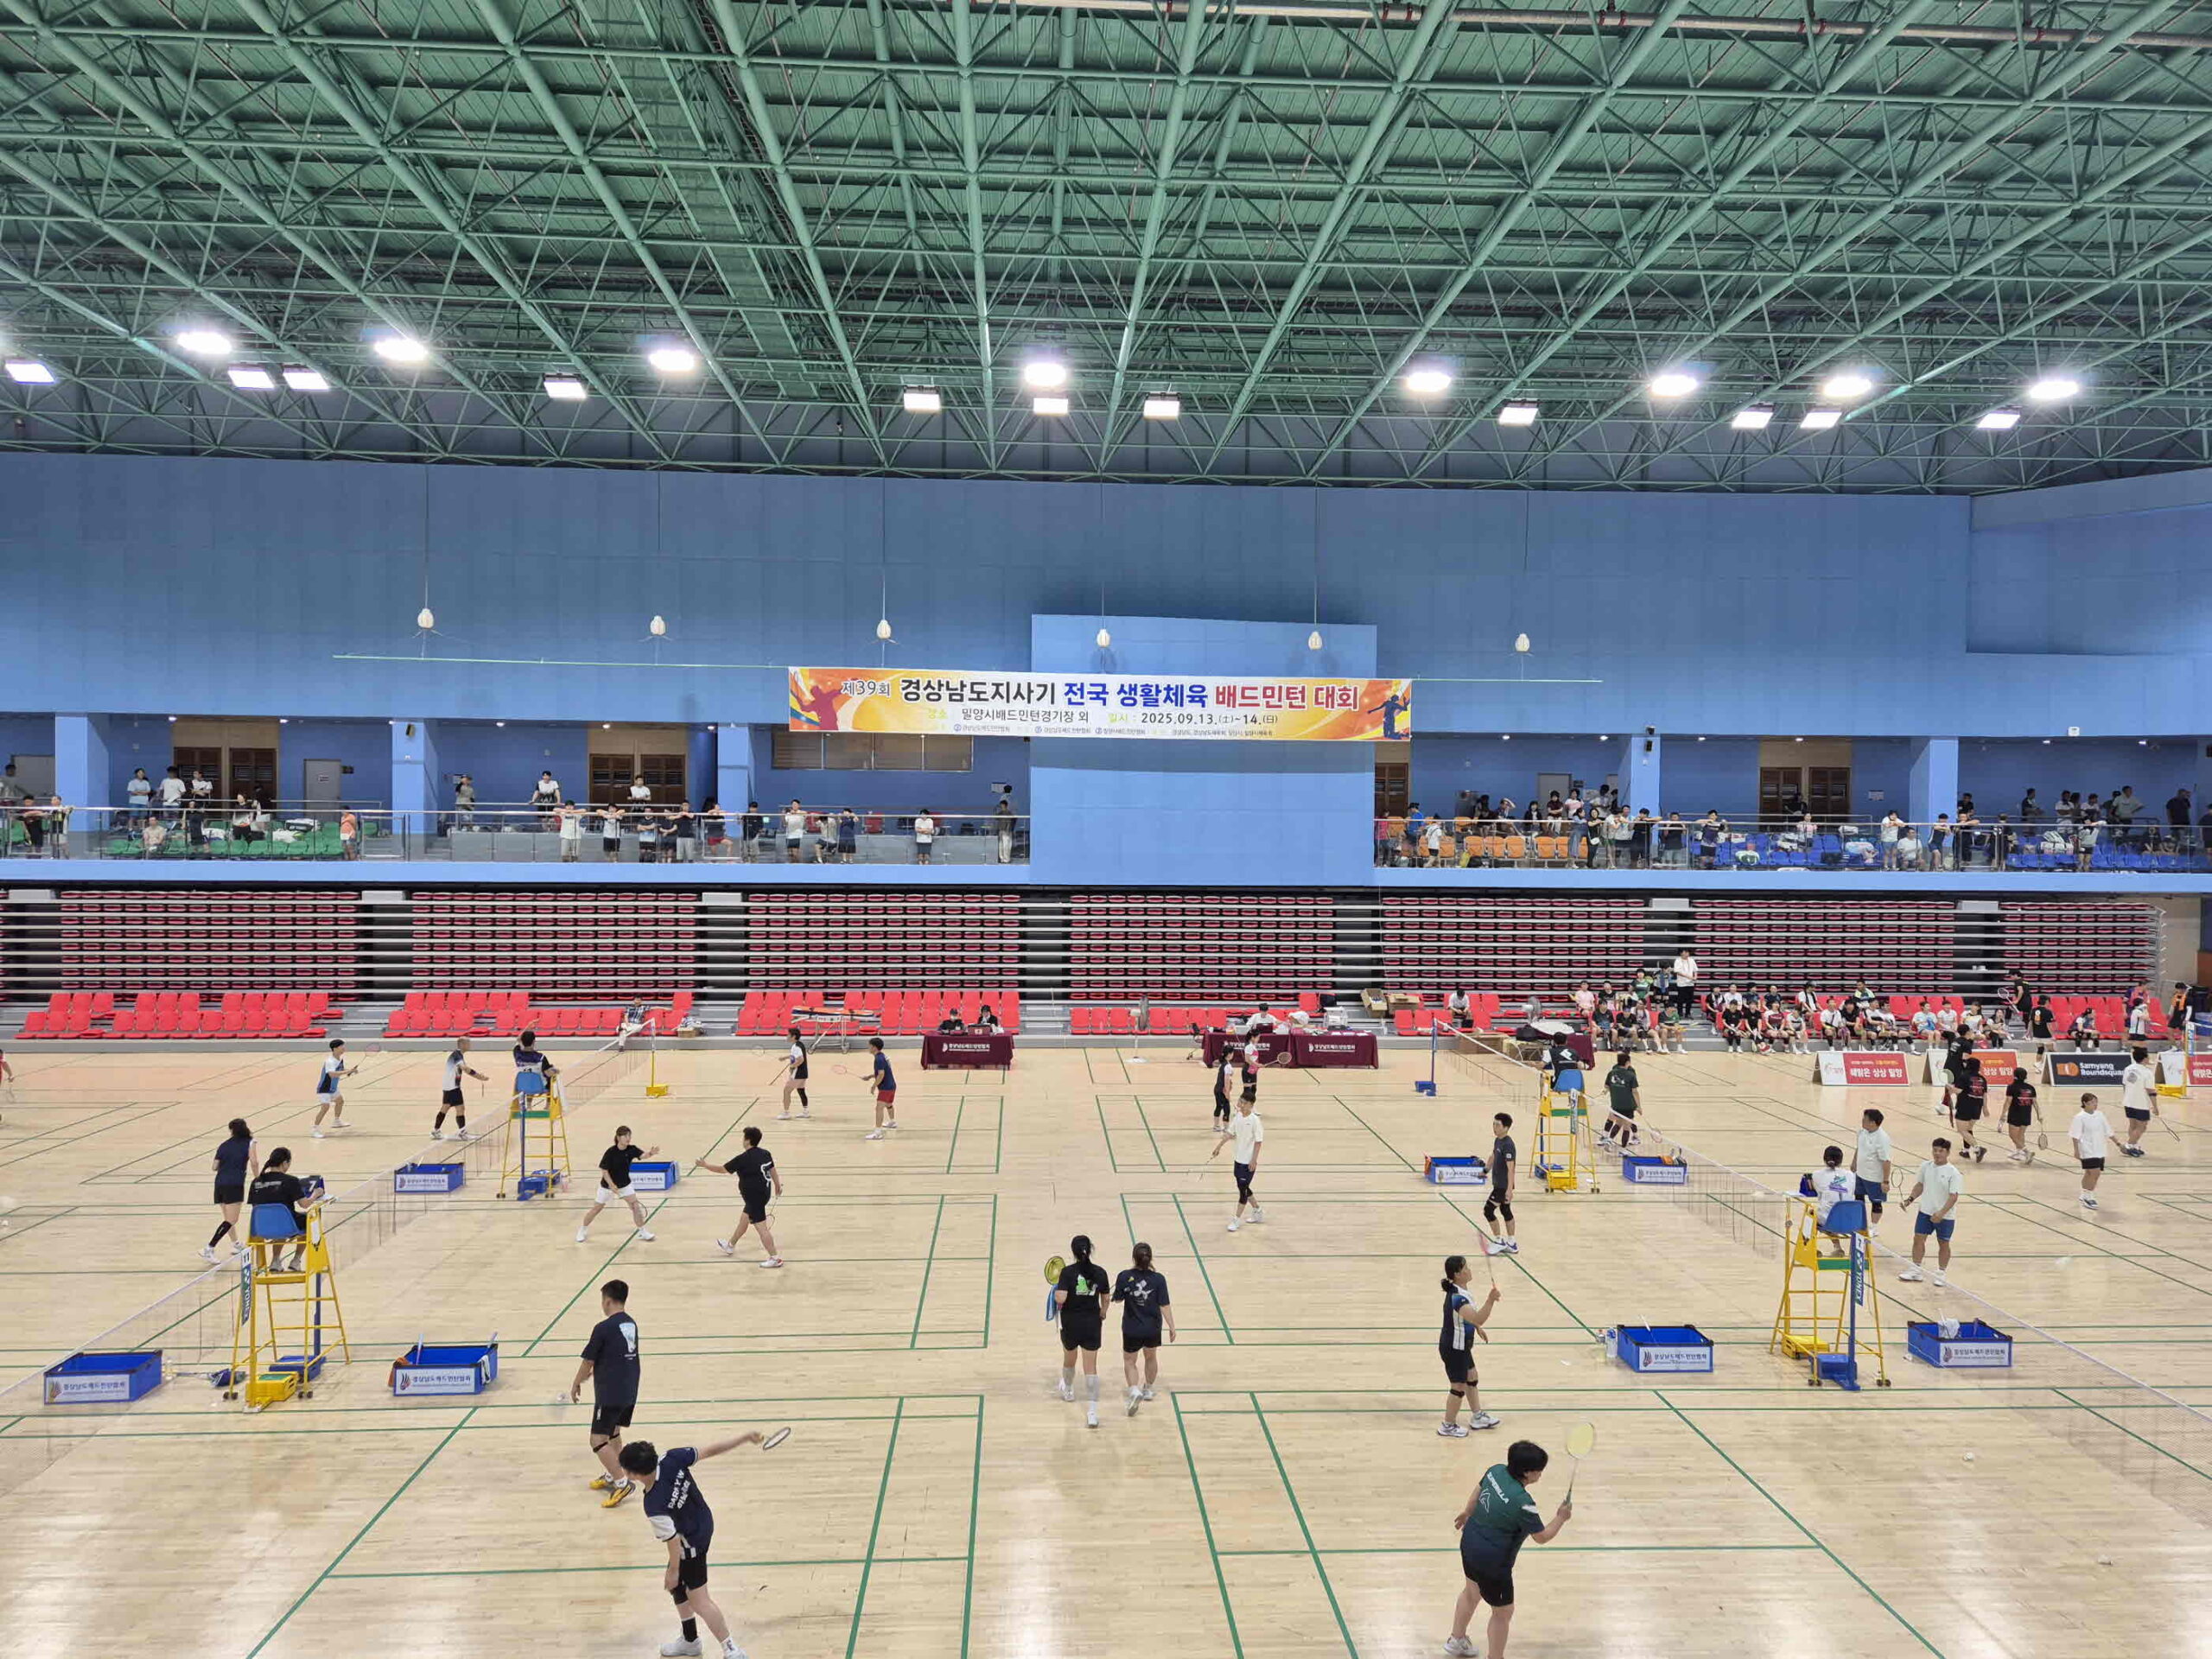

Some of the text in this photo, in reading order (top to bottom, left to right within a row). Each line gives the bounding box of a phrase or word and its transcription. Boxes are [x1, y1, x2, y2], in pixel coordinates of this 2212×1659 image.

[840, 678, 1359, 710] 제39회 경상남도지사기 전국 생활체육 배드민턴 대회
[962, 708, 1074, 722] 밀양시배드민턴경기장
[1078, 710, 1089, 723] 외
[2080, 1062, 2114, 1071] Samyang
[309, 1180, 317, 1192] 7
